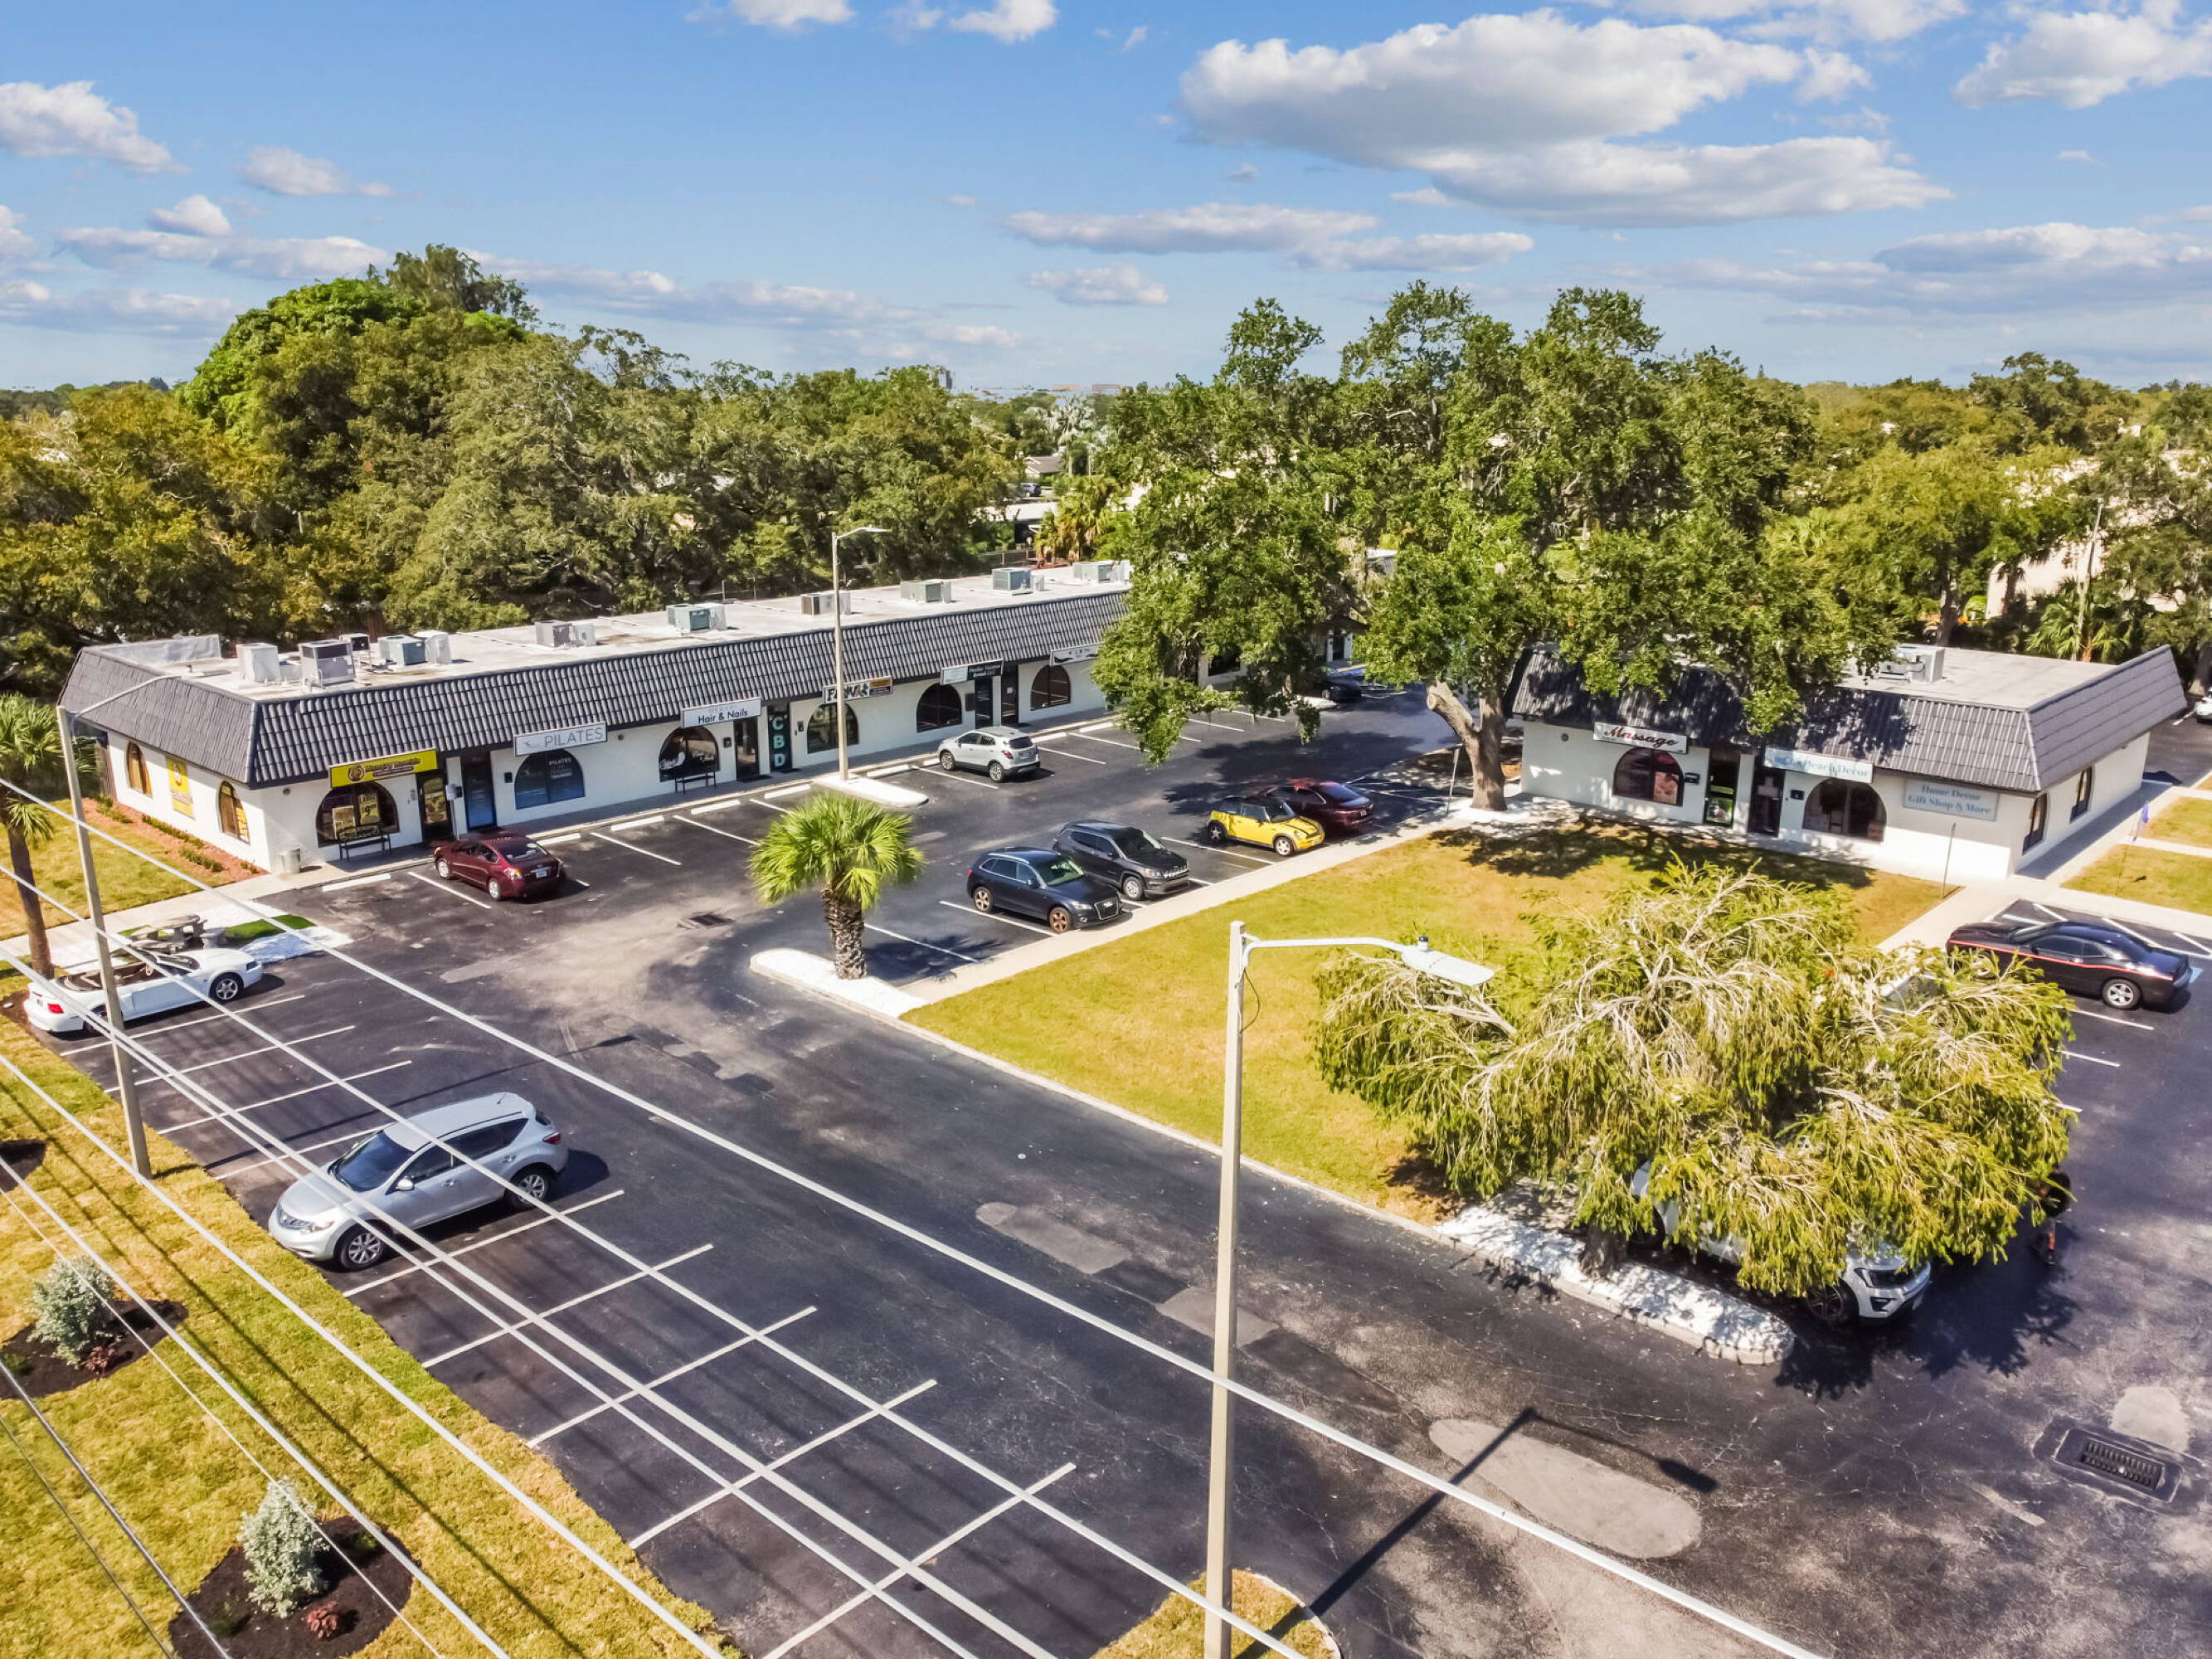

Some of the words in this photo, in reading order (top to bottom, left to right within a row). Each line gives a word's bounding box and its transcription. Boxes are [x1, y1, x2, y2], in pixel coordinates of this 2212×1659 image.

[698, 714, 716, 723] Hair
[718, 712, 724, 721] &
[727, 708, 748, 719] Nails
[544, 727, 603, 747] PILATES
[772, 716, 785, 767] CBD
[1604, 726, 1679, 747] Massage
[1929, 798, 1953, 810] Shop
[1966, 803, 1991, 814] More
